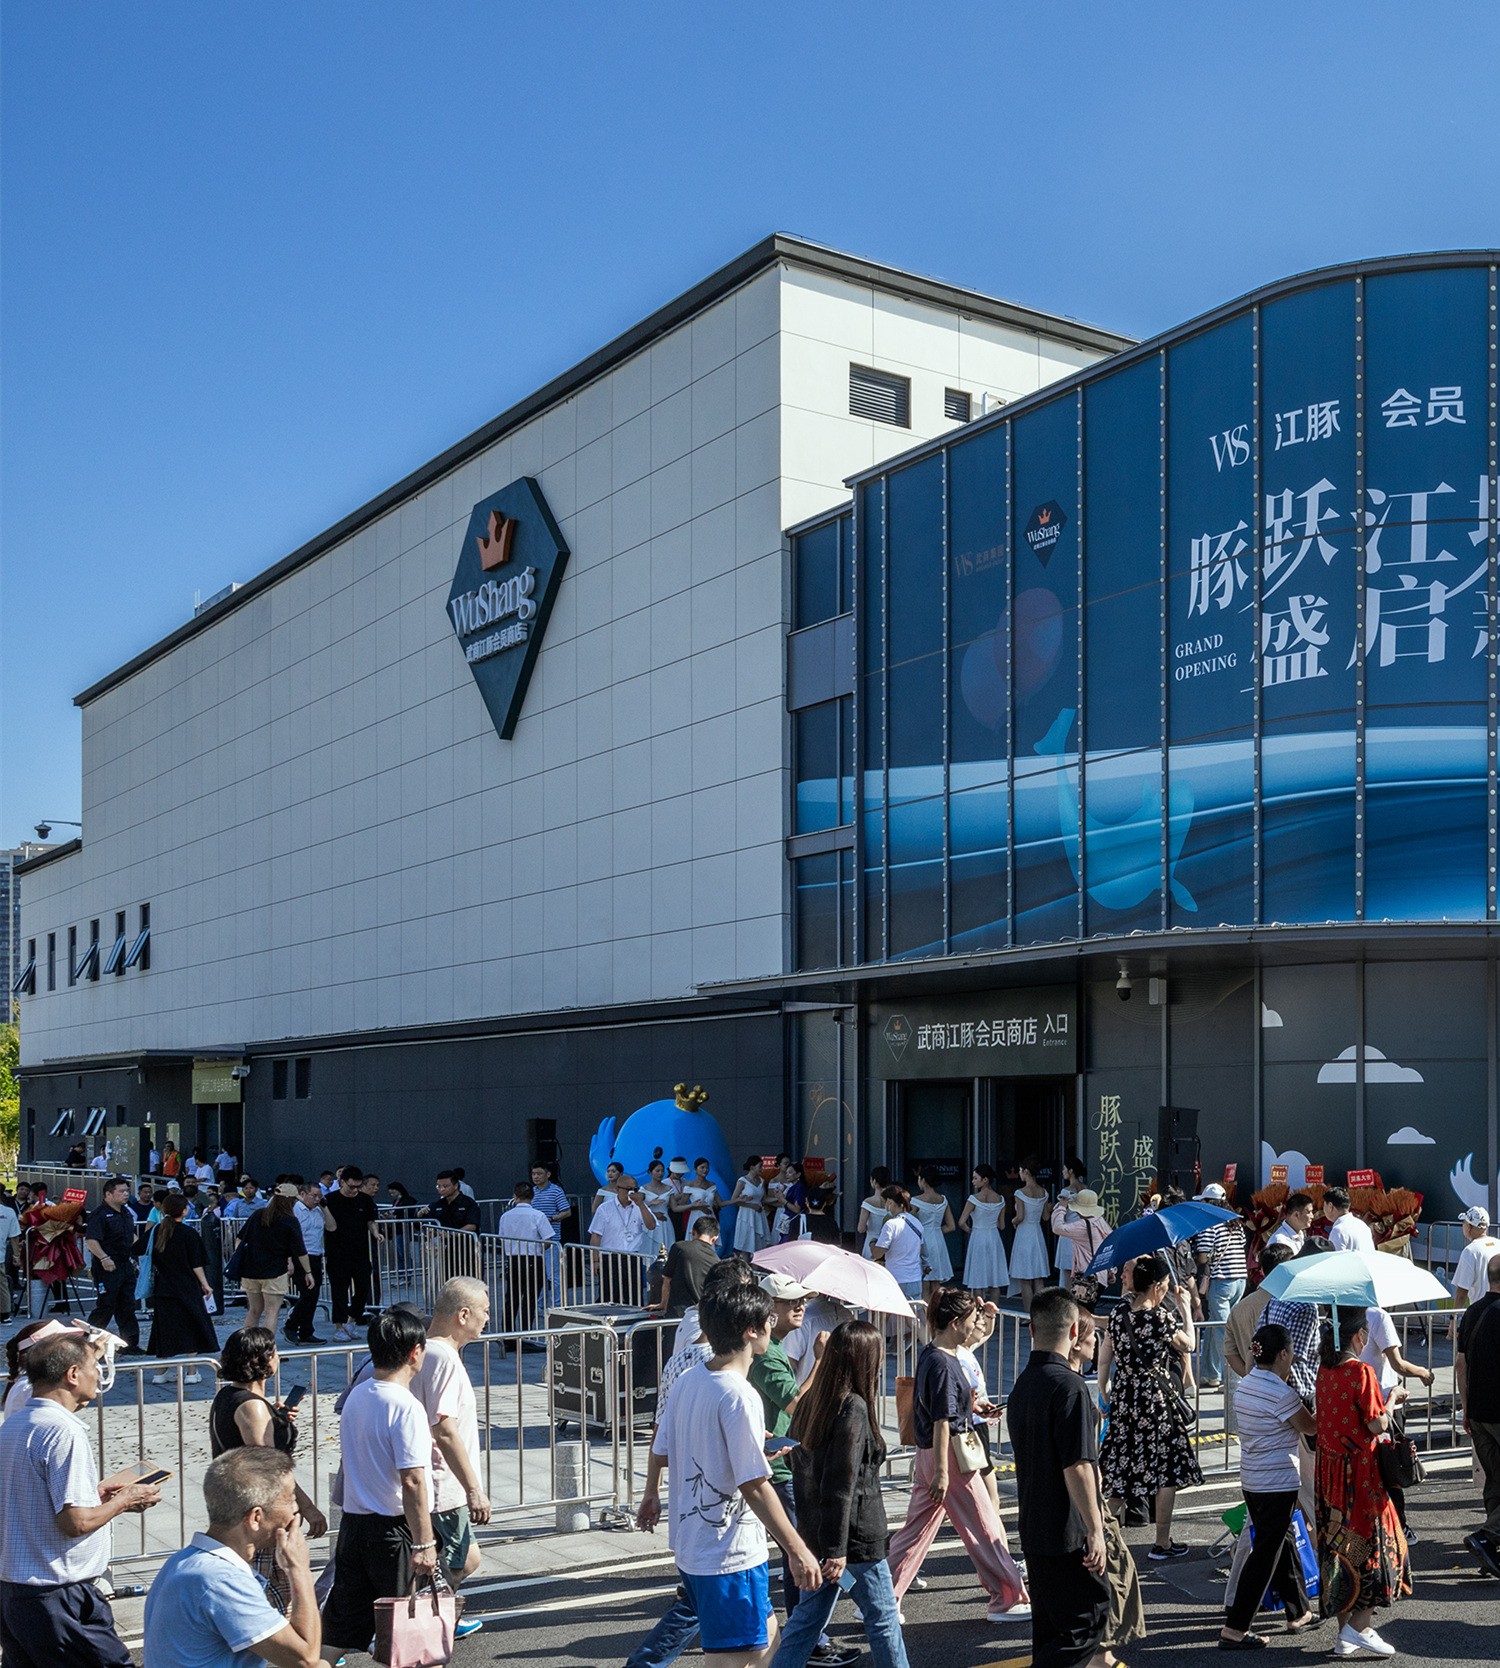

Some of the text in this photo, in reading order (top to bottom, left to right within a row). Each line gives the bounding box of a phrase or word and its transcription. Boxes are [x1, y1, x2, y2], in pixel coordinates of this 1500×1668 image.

[1209, 423, 1251, 473] WS
[1027, 522, 1061, 543] WuShang
[451, 566, 536, 638] WuShang
[1175, 633, 1224, 659] GRAND
[1175, 652, 1237, 681] OPENING
[917, 1017, 1038, 1050] 武商江豚会员商店
[1043, 1013, 1068, 1034] 入口
[1043, 1038, 1067, 1047] Entrance
